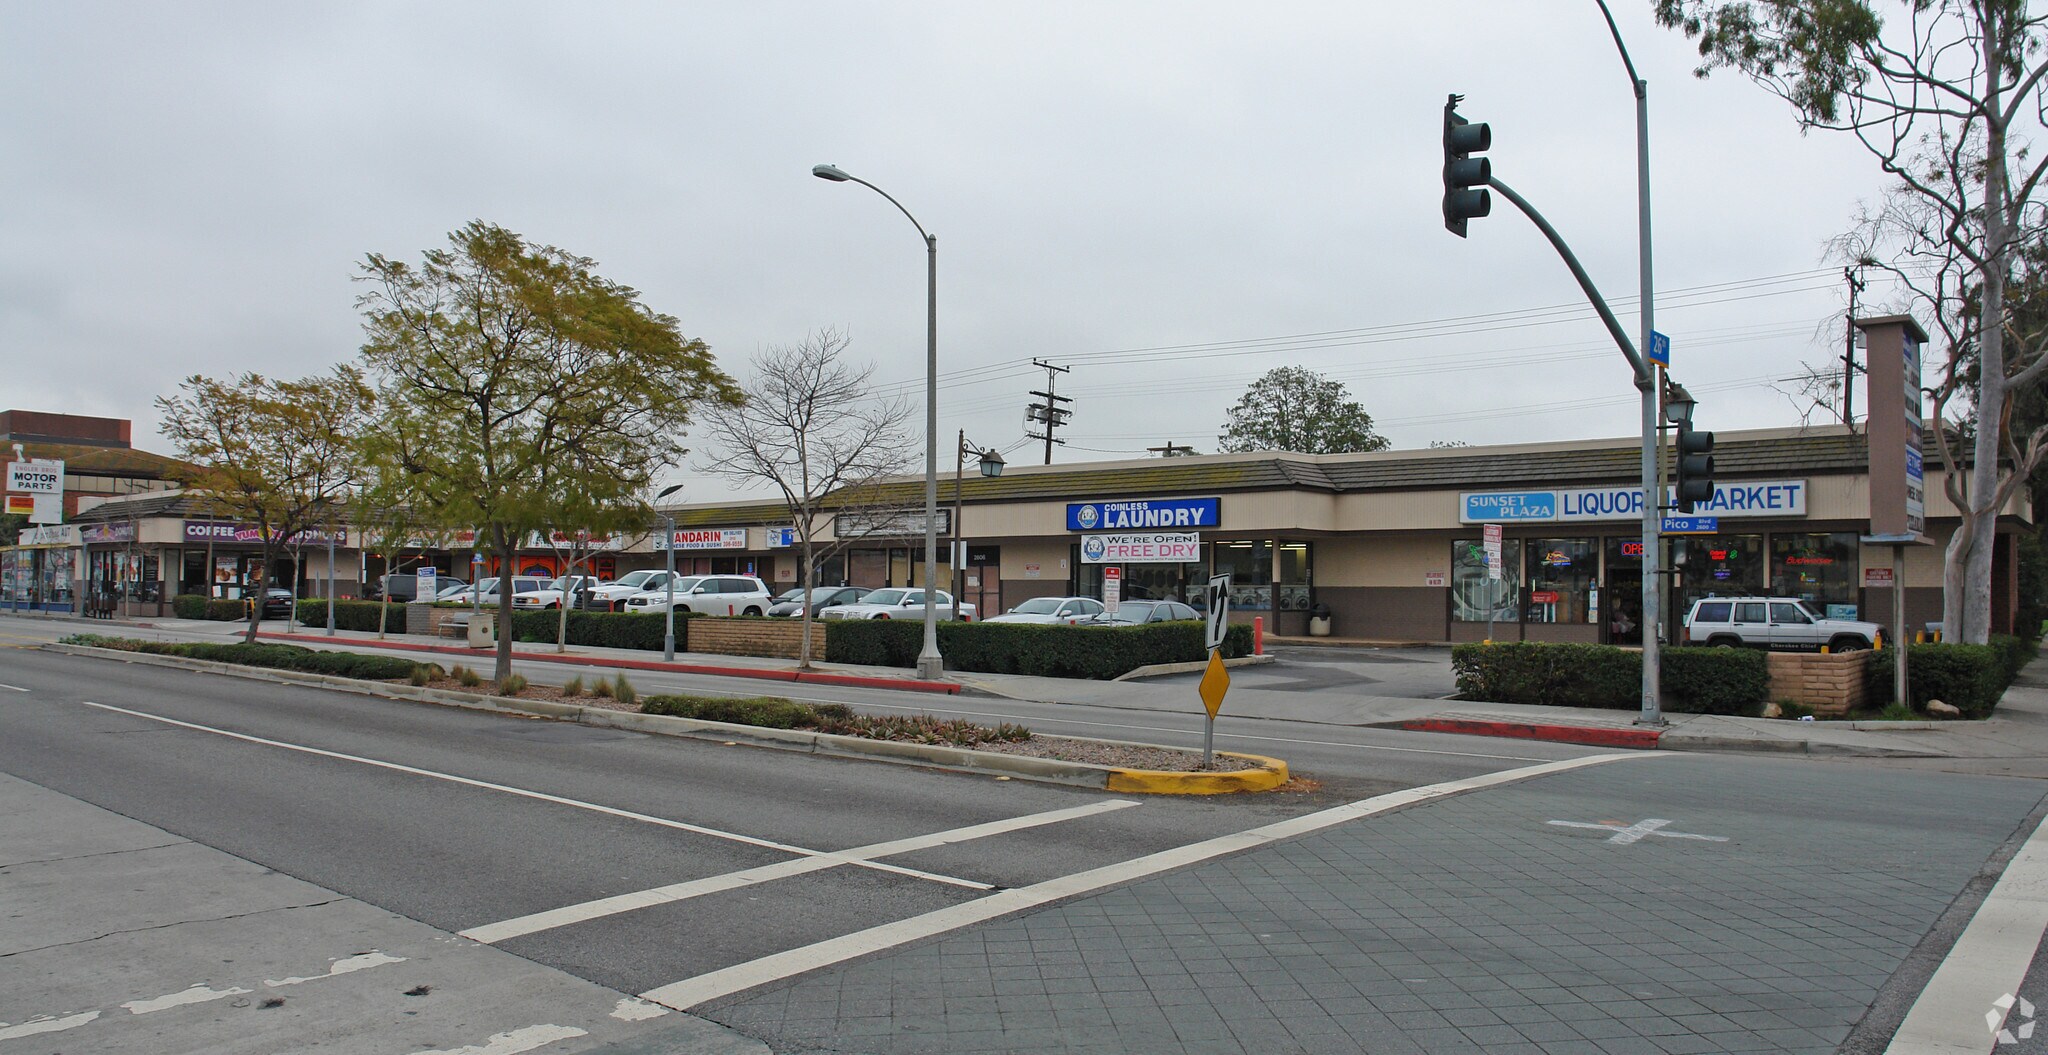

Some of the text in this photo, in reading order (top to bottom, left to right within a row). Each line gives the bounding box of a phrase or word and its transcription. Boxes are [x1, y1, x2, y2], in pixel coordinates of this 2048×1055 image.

[14, 473, 57, 482] MOTOR
[18, 482, 53, 490] PARTS
[1104, 502, 1148, 511] COINLESS
[1469, 495, 1526, 507] SUNSET
[1500, 506, 1551, 518] PLAZA
[1104, 508, 1205, 528] LAUNDRY
[1664, 519, 1689, 529] Pico
[186, 525, 235, 537] COFFEE
[235, 530, 258, 541] YUM
[674, 531, 721, 543] ANDARIN
[1107, 544, 1197, 557] FREE DRY
[1623, 543, 1644, 554] OPE
